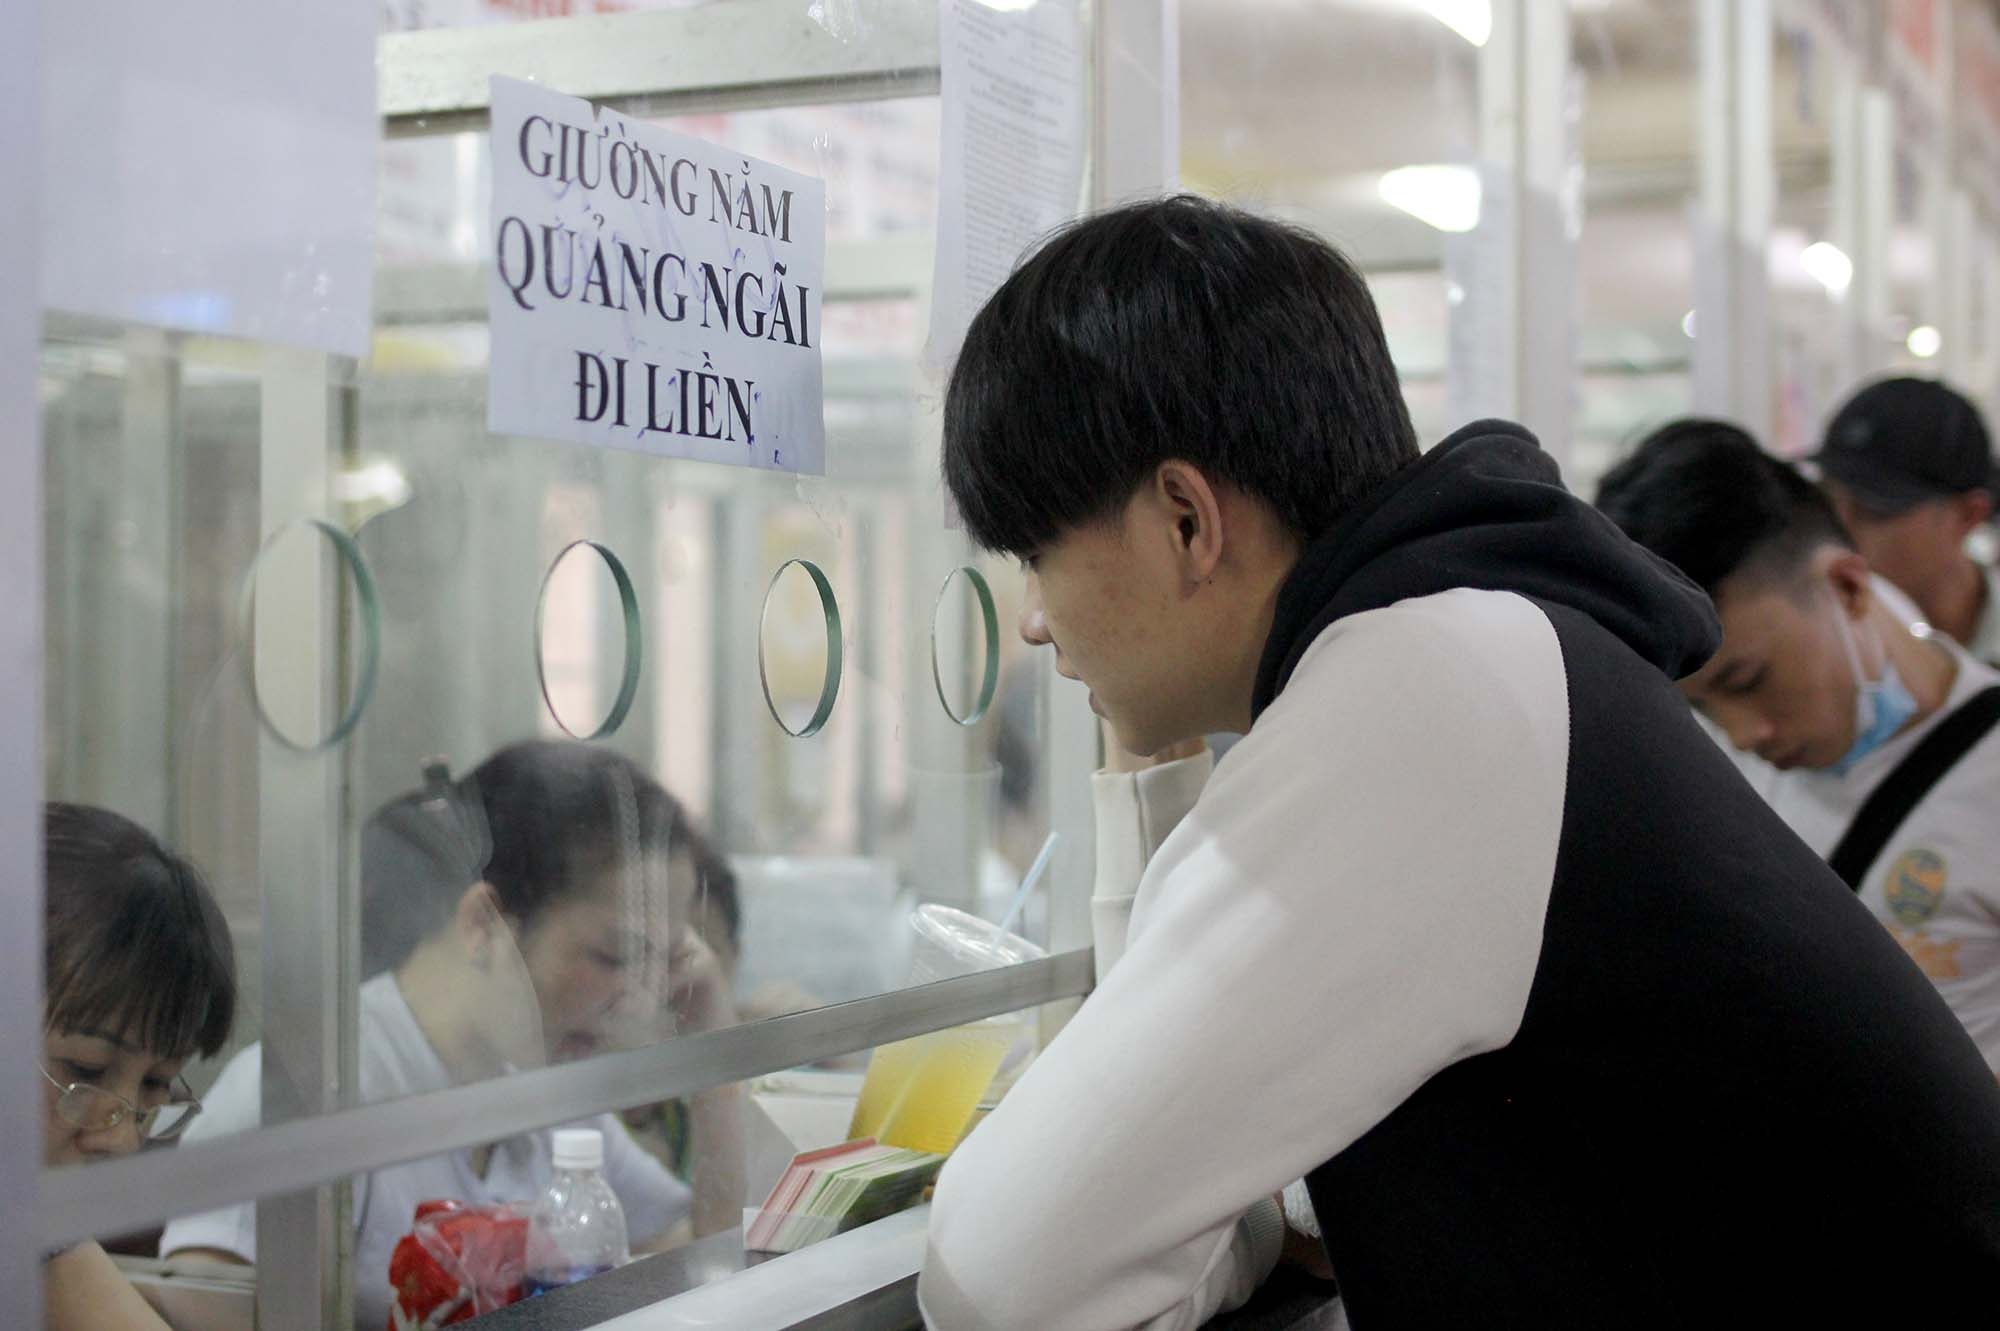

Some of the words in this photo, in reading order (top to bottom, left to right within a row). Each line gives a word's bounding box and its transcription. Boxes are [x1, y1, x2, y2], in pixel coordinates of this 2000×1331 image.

[518, 115, 699, 217] GIƯỜNG
[707, 160, 794, 243] NẰM
[496, 213, 689, 323] QUẢNG
[698, 261, 812, 348] NGÃI
[573, 350, 630, 427] ĐI
[643, 351, 756, 443] LIỀN
